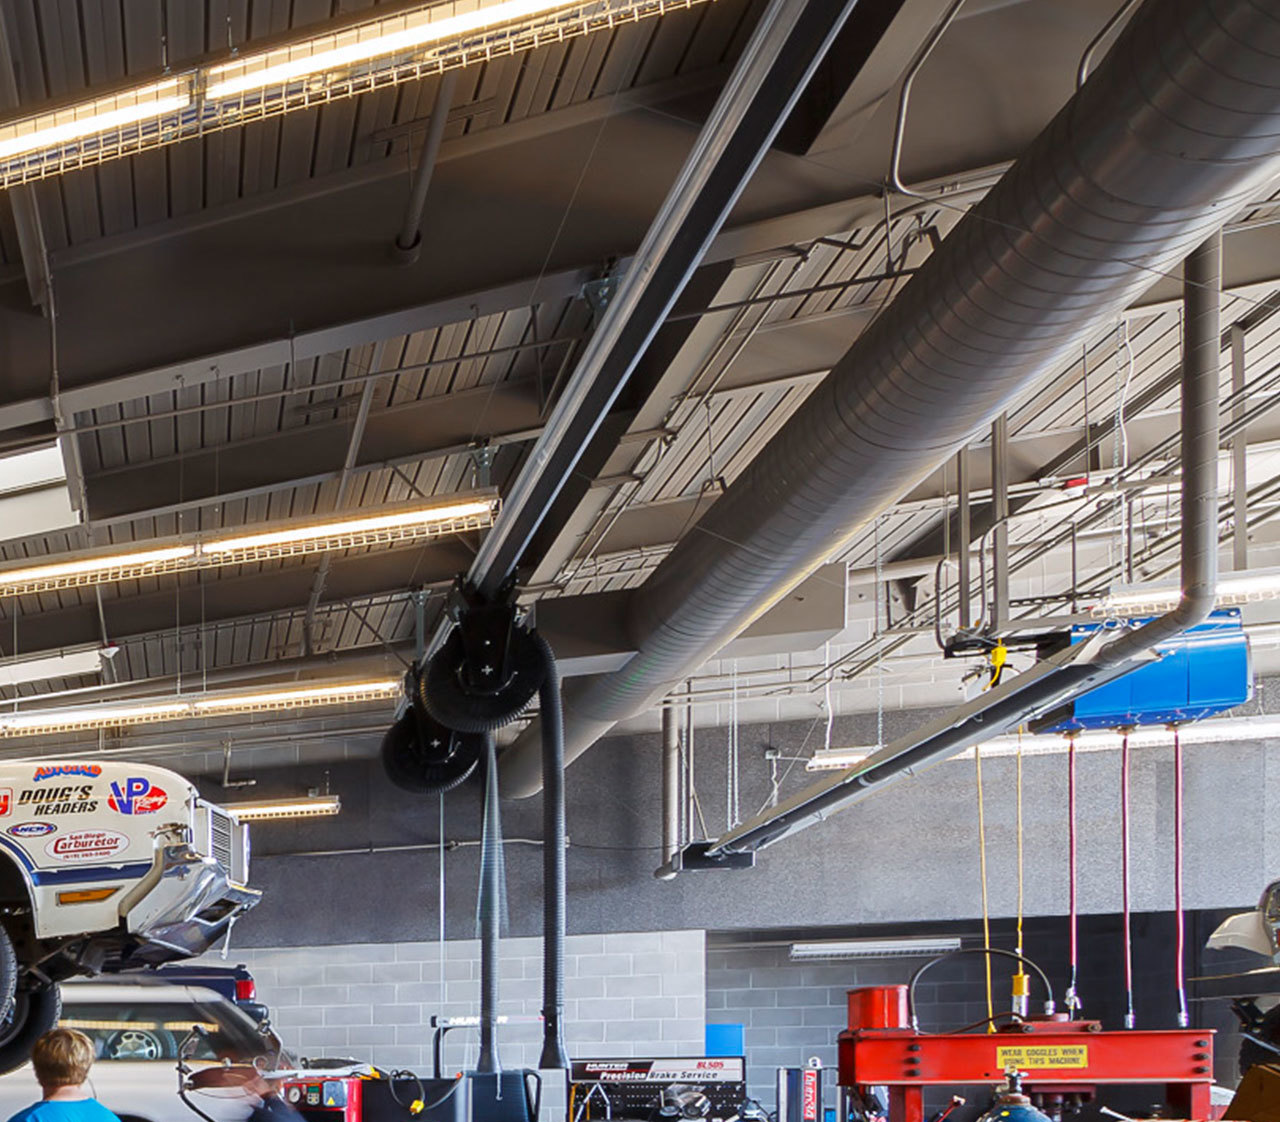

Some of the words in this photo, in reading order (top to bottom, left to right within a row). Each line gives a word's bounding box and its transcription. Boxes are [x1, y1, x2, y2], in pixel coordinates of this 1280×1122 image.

[18, 785, 93, 805] DOUG'S
[34, 801, 99, 816] HEADERS
[53, 837, 121, 854] Carburetor
[1026, 1048, 1058, 1056] GOGGLES
[600, 1072, 647, 1081] Precision
[649, 1071, 677, 1080] Brake
[680, 1071, 718, 1079] Service
